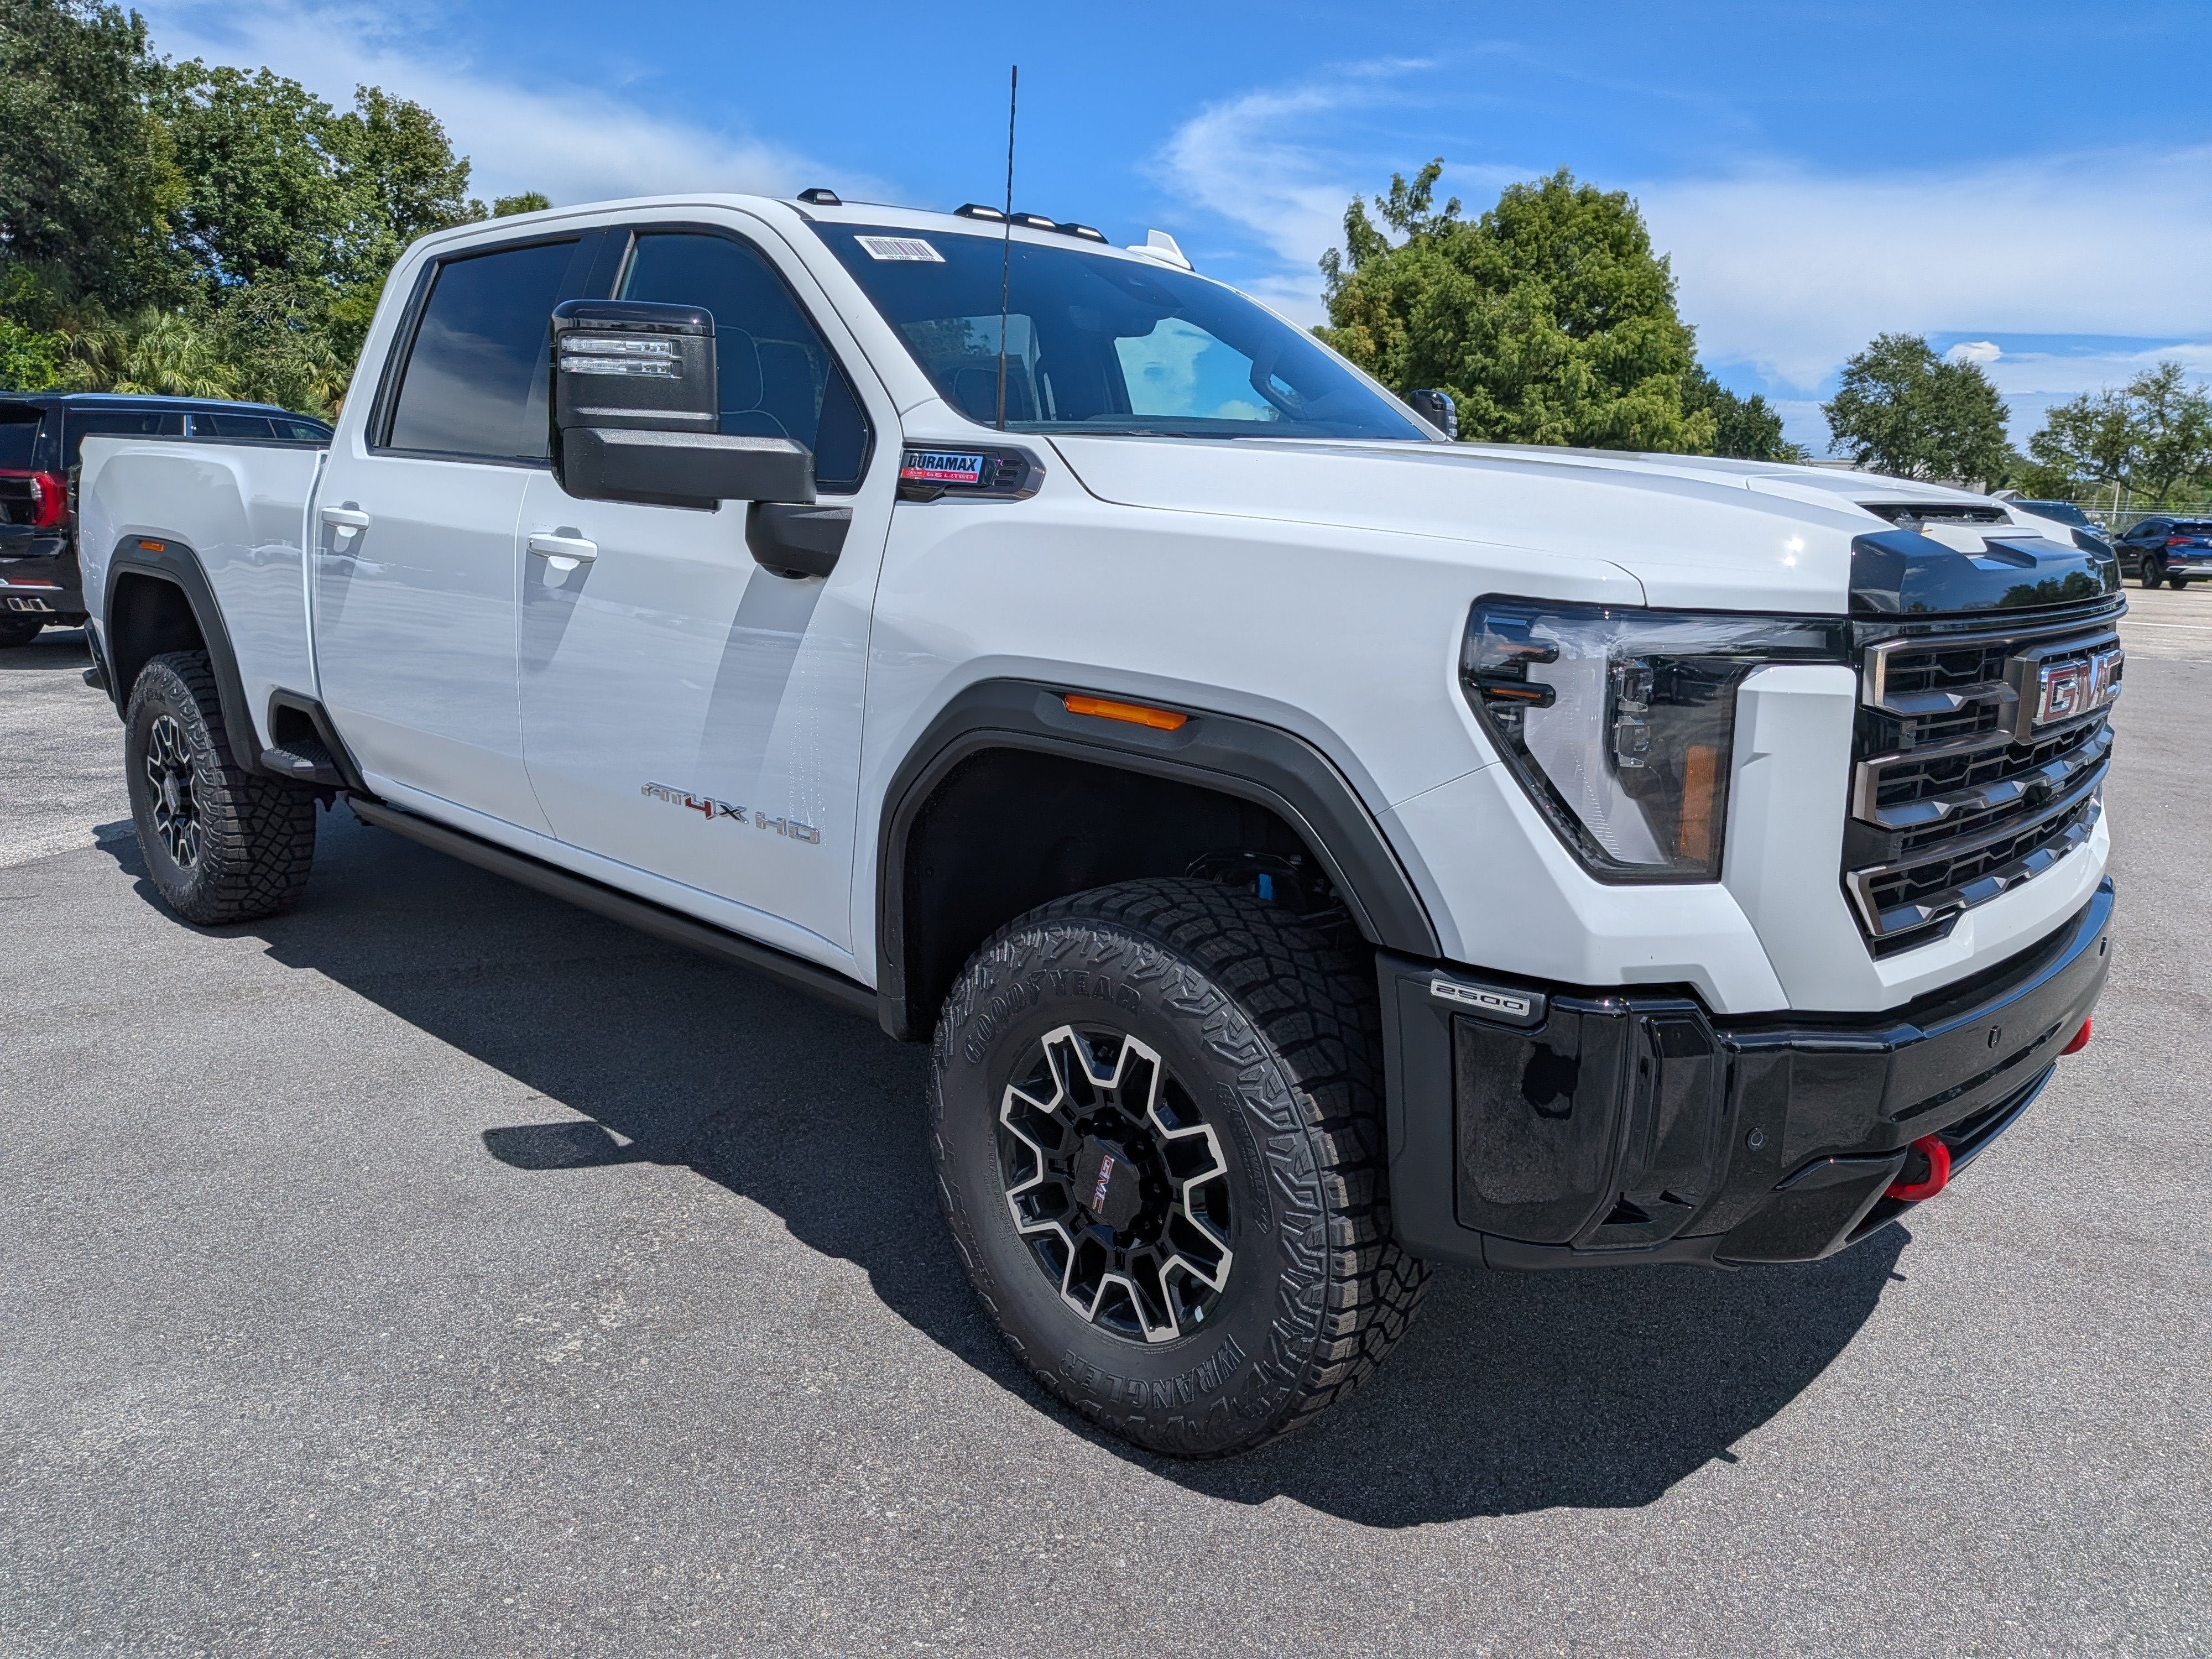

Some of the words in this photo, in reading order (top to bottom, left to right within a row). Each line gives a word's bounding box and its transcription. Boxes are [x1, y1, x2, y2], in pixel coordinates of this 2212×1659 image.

[907, 455, 977, 472] DURAMAX
[2037, 649, 2122, 726] GMC
[641, 781, 749, 824] AT4X
[755, 811, 820, 844] HD
[963, 969, 1142, 1064] GOODYEAR
[1436, 984, 1524, 1010] 2500
[1092, 1155, 1115, 1214] GMC
[1060, 1333, 1247, 1410] WRANGLER
